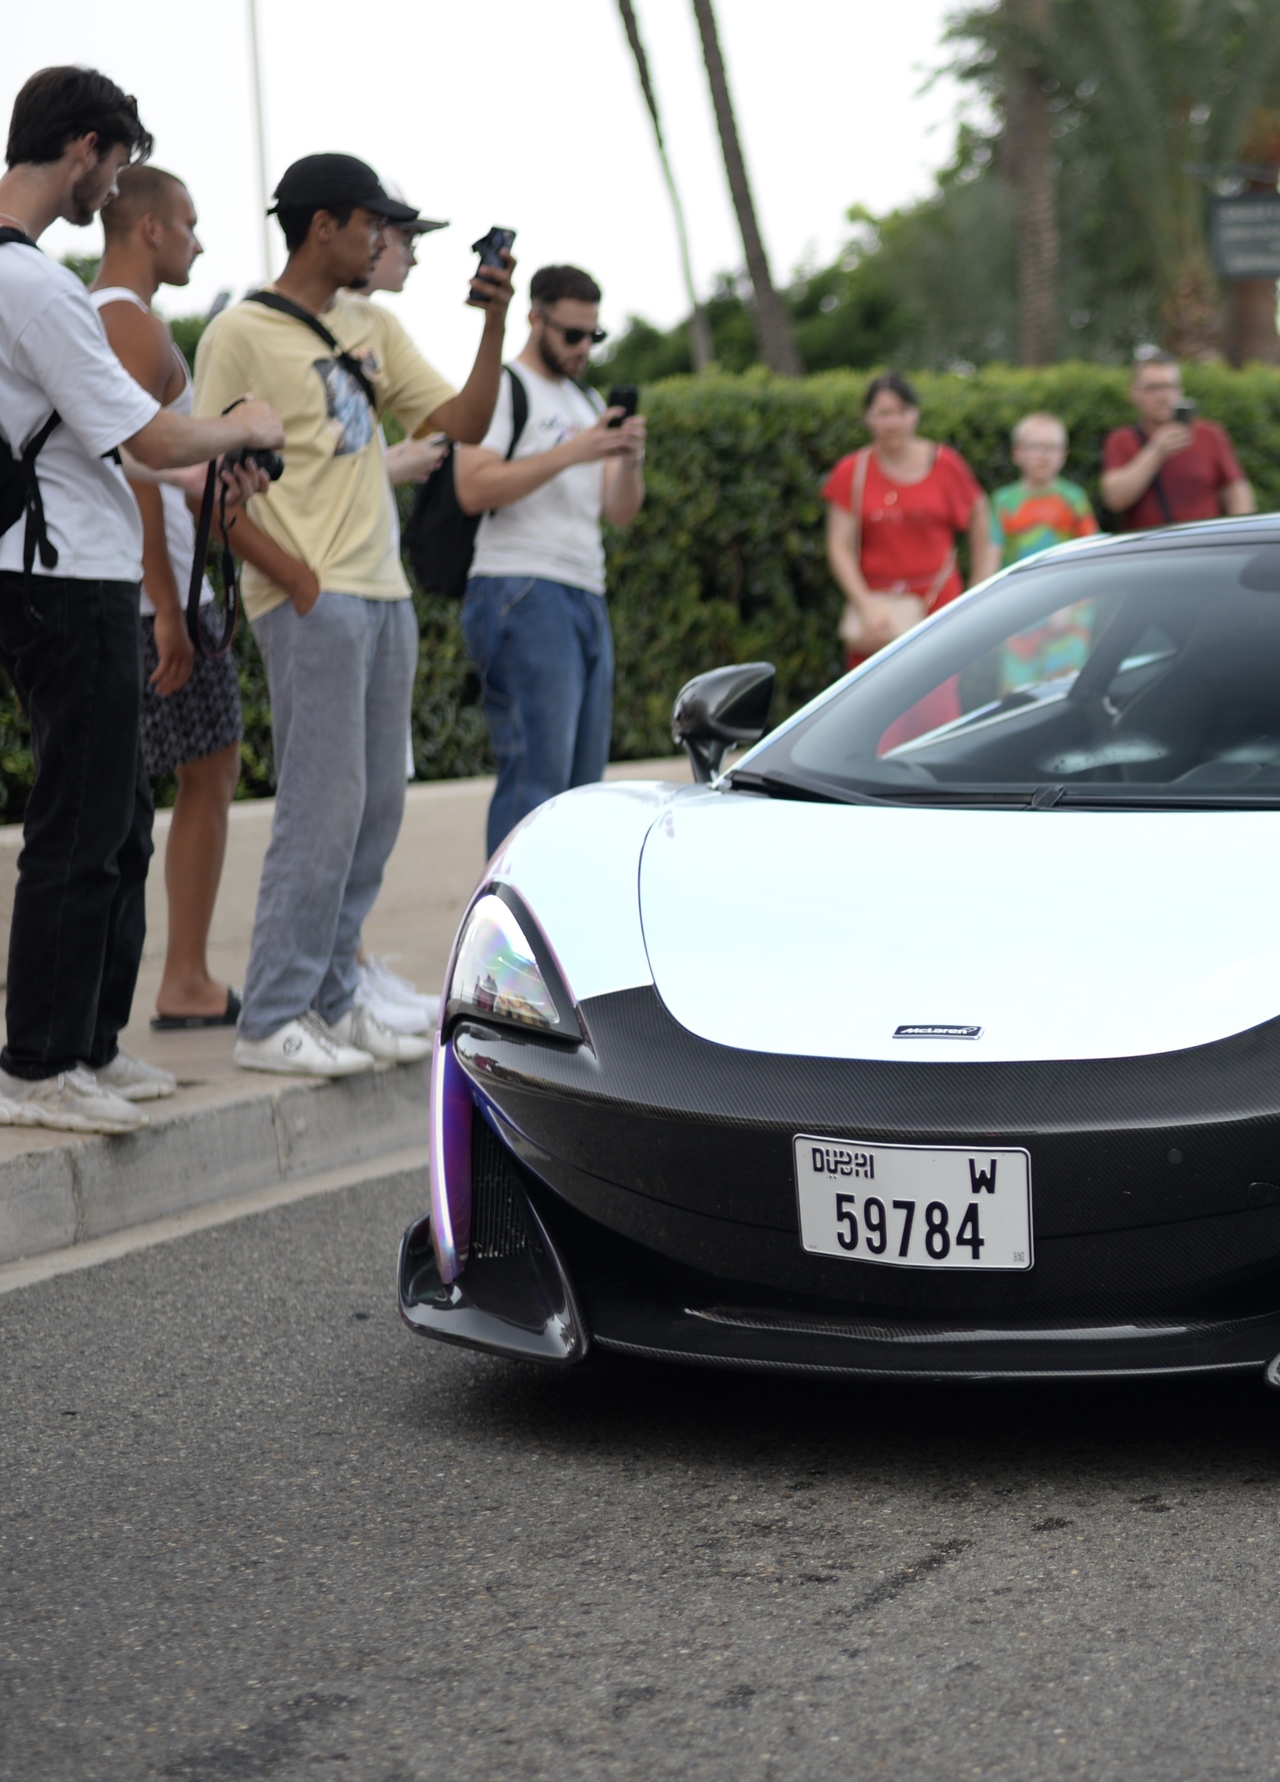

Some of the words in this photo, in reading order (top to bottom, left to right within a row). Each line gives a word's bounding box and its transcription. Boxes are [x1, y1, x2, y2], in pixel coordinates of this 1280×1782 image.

[811, 1147, 875, 1179] DUBAI
[969, 1158, 997, 1194] W
[836, 1192, 985, 1260] 59784
